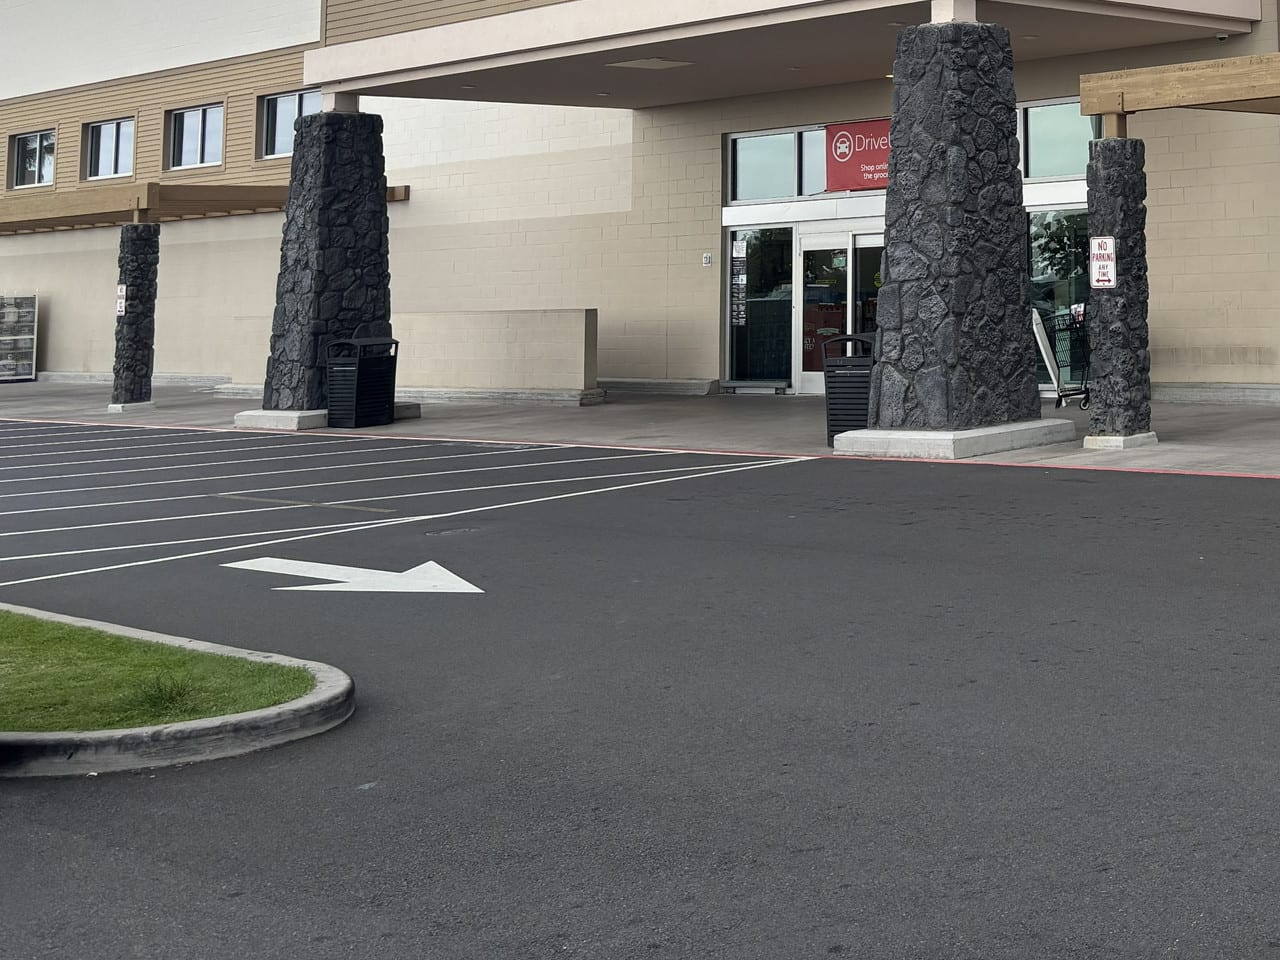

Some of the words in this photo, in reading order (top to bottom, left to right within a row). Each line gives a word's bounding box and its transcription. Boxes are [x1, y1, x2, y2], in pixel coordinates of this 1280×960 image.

[860, 164, 875, 172] Shop
[863, 172, 873, 180] the
[1098, 241, 1108, 251] NO
[1092, 253, 1114, 262] PARKING
